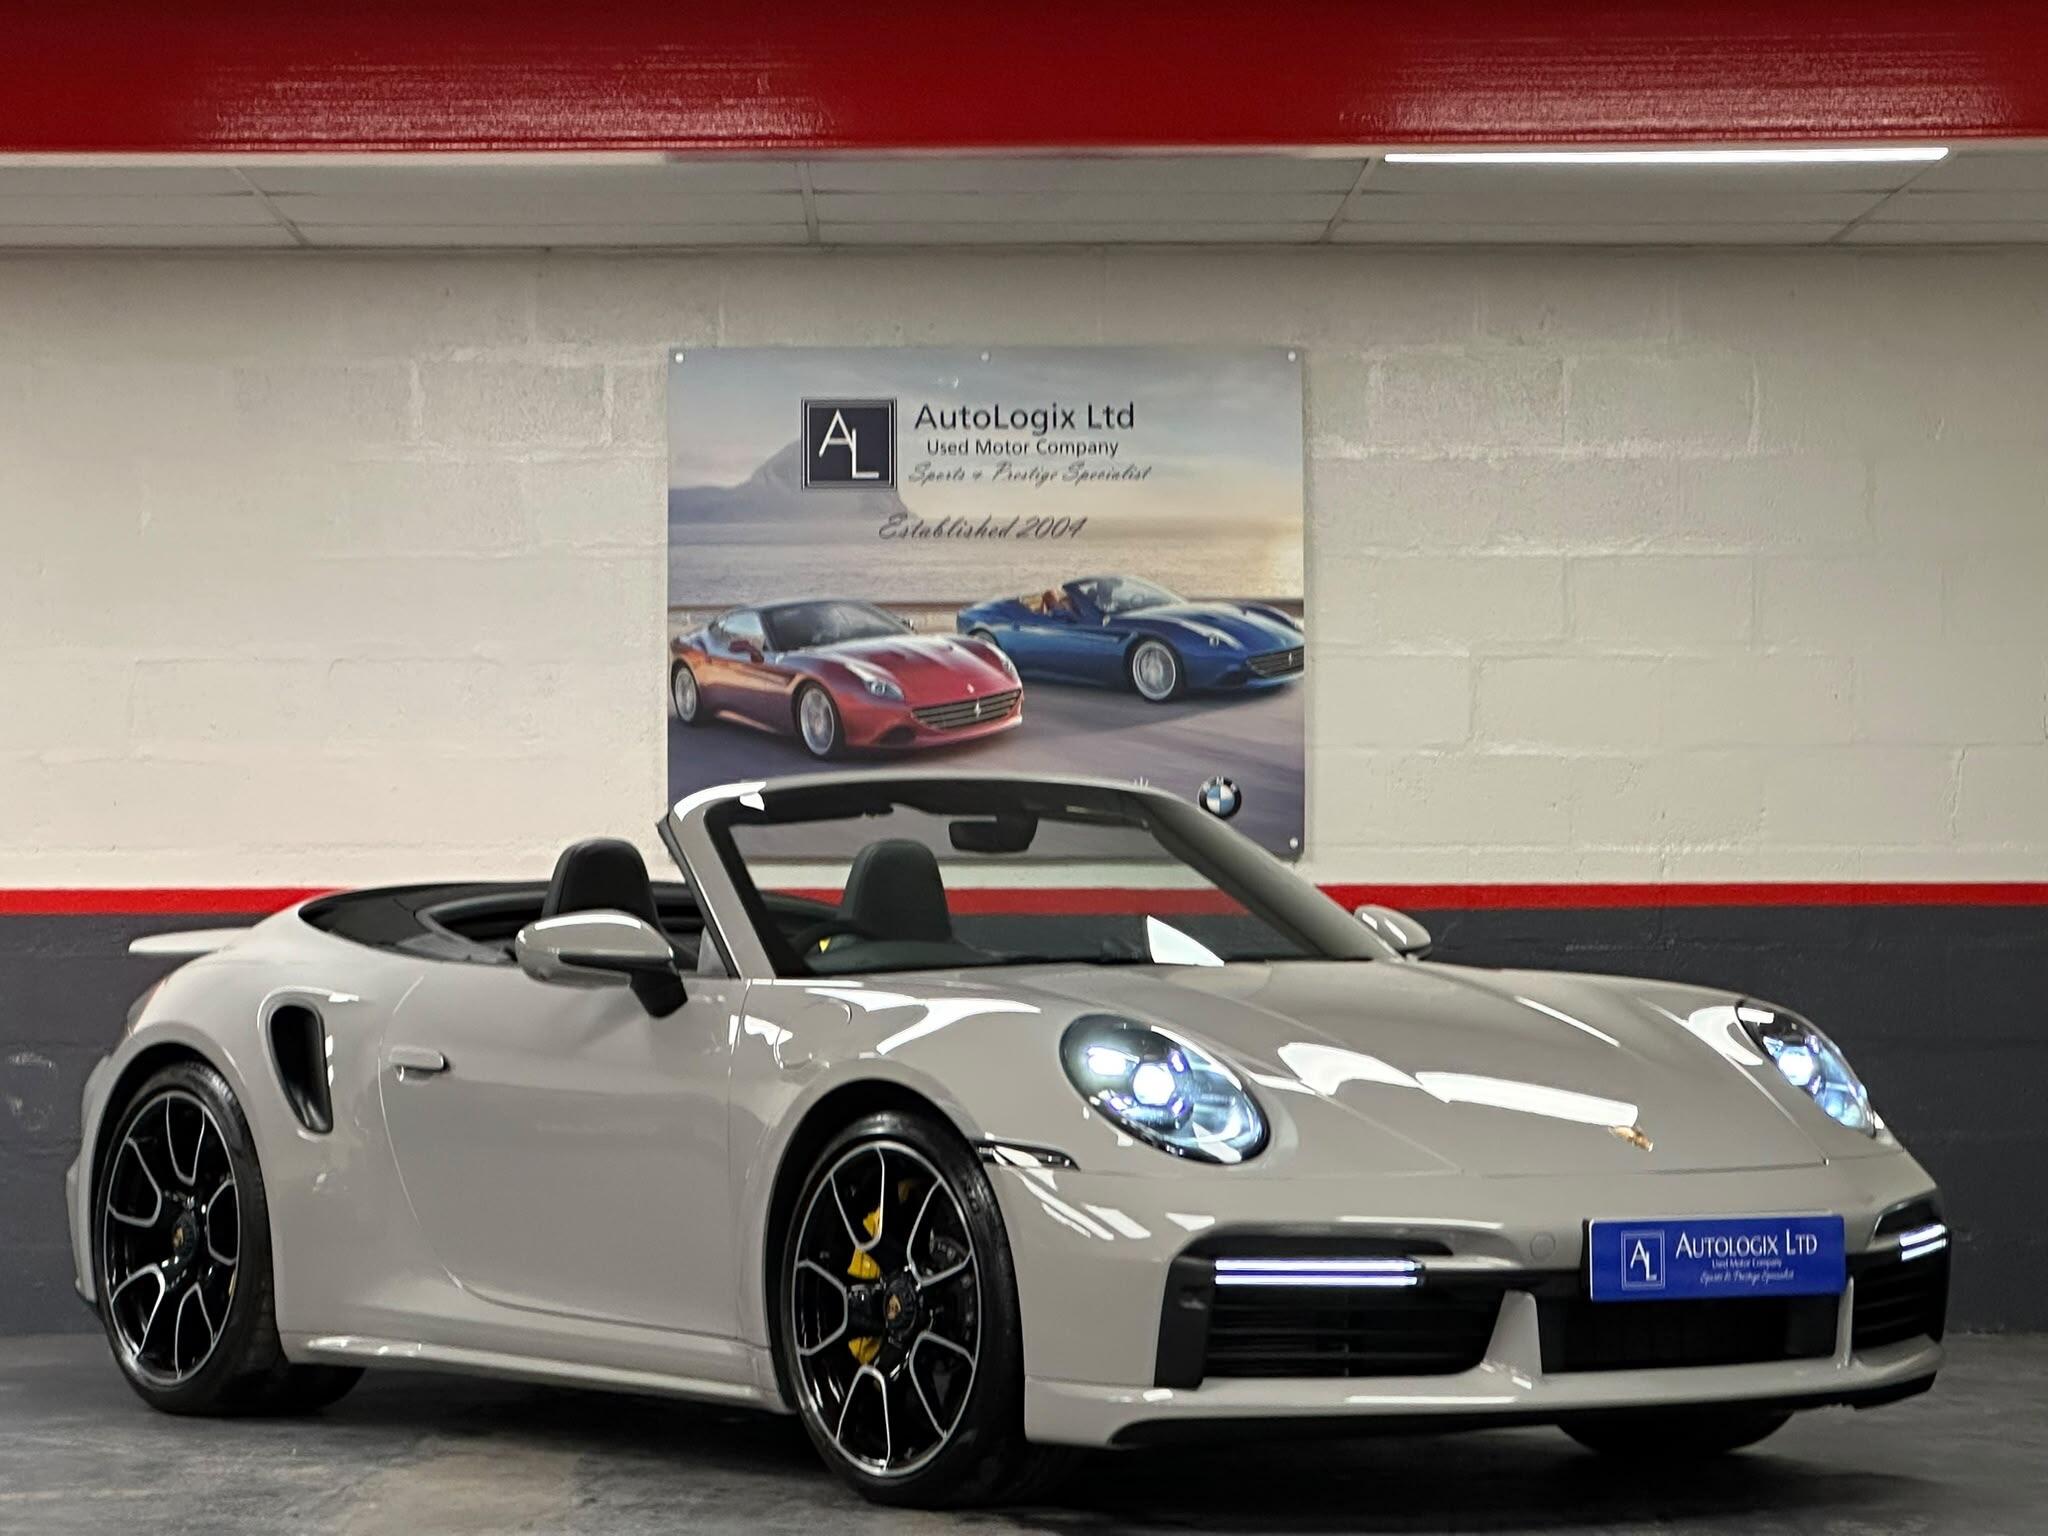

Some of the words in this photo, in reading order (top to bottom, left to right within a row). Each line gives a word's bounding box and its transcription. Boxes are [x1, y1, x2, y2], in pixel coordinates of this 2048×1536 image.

[914, 402, 1076, 436] AutoLogix
[1087, 402, 1135, 430] Ltd
[926, 438, 969, 456] Used
[975, 438, 1030, 456] Motor
[1036, 438, 1119, 458] Company
[908, 460, 966, 487] Sports
[991, 460, 1058, 488] Prestige
[1061, 460, 1153, 487] Specialist
[878, 511, 1020, 540] Established
[1015, 515, 1088, 540] 2004
